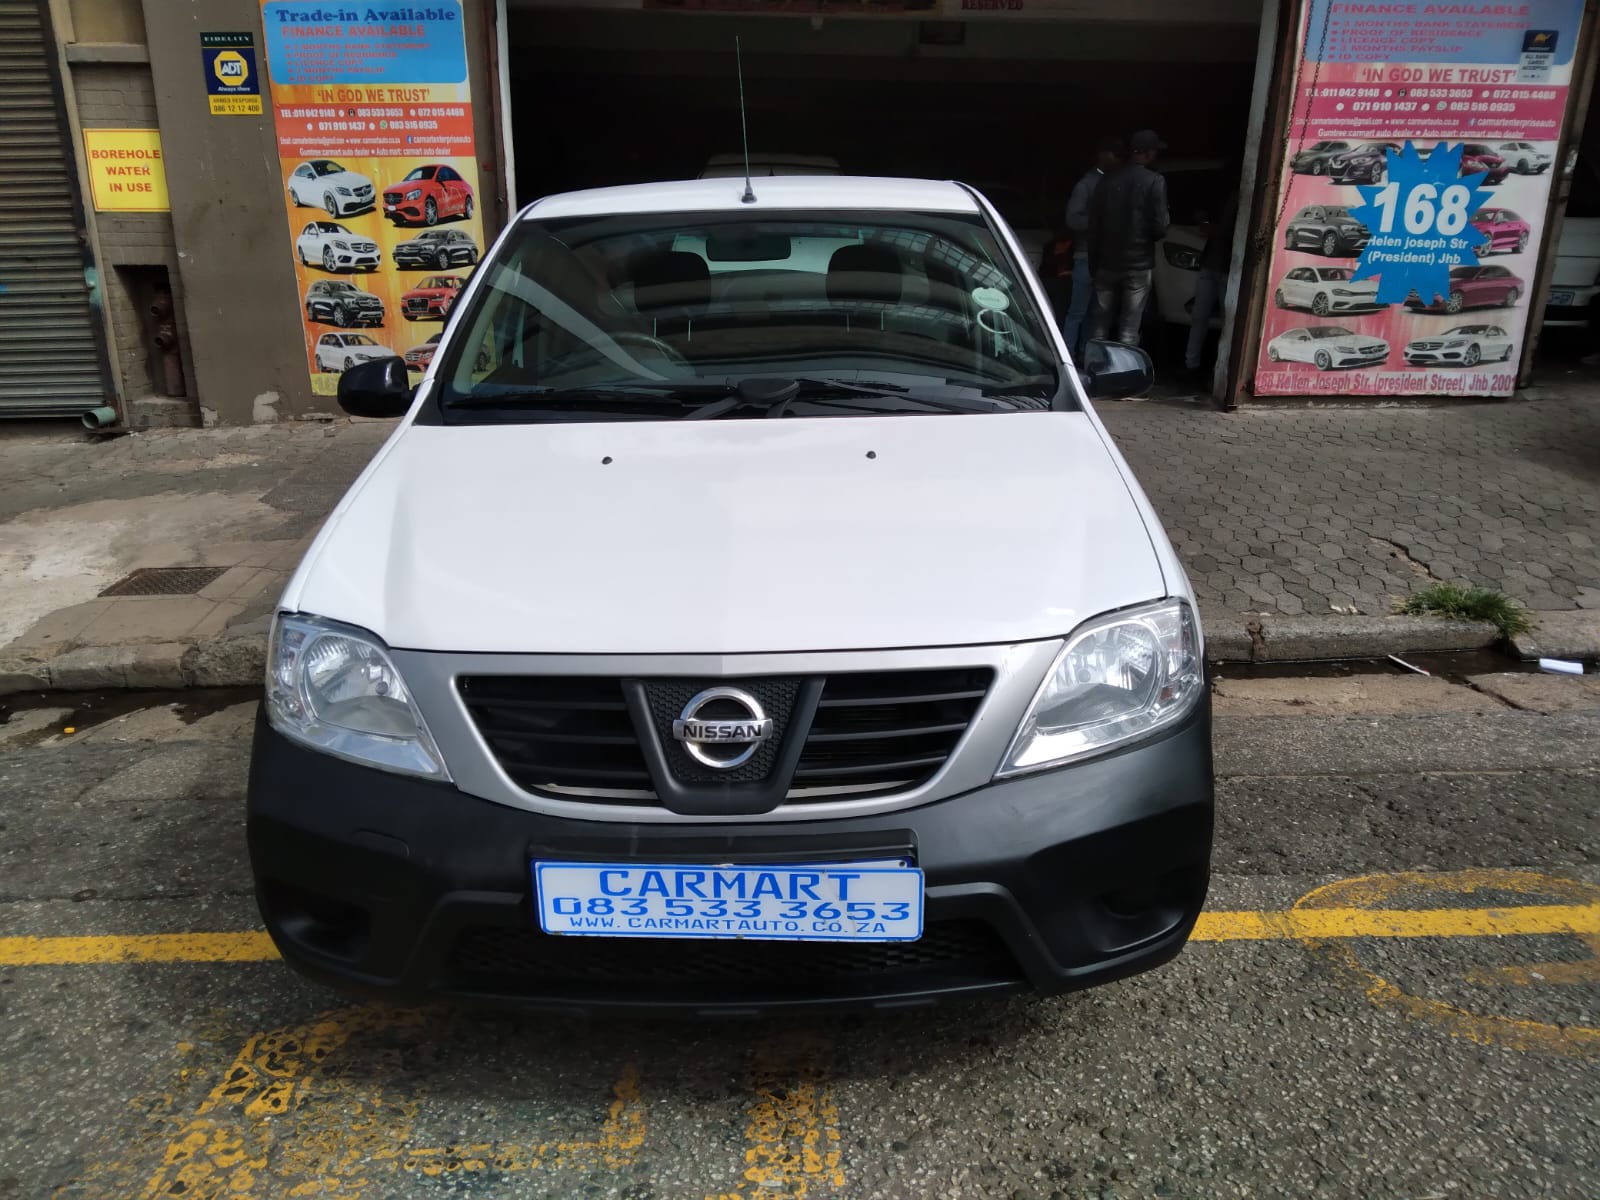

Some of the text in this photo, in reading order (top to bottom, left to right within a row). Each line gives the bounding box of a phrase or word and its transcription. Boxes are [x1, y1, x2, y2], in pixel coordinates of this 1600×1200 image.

[276, 8, 455, 22] Trade-in Available
[1332, 4, 1530, 16] FINANCE AVAILABLE
[282, 25, 425, 37] FINANCE AVAILABLE
[1410, 29, 1484, 37] RESIDENCE
[1351, 45, 1406, 53] MONTHS
[221, 62, 242, 75] ADT
[1388, 68, 1425, 82] GOD
[1428, 68, 1453, 82] WE
[338, 89, 363, 102] GOD
[365, 89, 384, 102] WE
[1410, 88, 1428, 98] 083
[1429, 88, 1448, 98] 533
[1493, 90, 1511, 99] 072
[228, 105, 235, 113] 12
[238, 105, 245, 113] 12
[1353, 102, 1372, 111] 071
[1394, 102, 1418, 111] 1437
[1450, 102, 1470, 111] 083
[1477, 119, 1556, 128] carmartenterpriseauto
[91, 149, 161, 159] BOREHOLE
[105, 166, 151, 176] WATER
[109, 183, 153, 192] IN USE
[1374, 182, 1471, 236] 168
[1367, 235, 1402, 247] Helen
[1450, 238, 1469, 249] Str
[1367, 250, 1461, 265] (President) Jhb
[1313, 373, 1351, 392] Joseph
[1430, 373, 1467, 392] Street)
[1469, 374, 1489, 391] Jhb
[683, 724, 762, 739] NISSAN
[599, 869, 860, 901] CARMART
[553, 897, 911, 921] 083 533 3653
